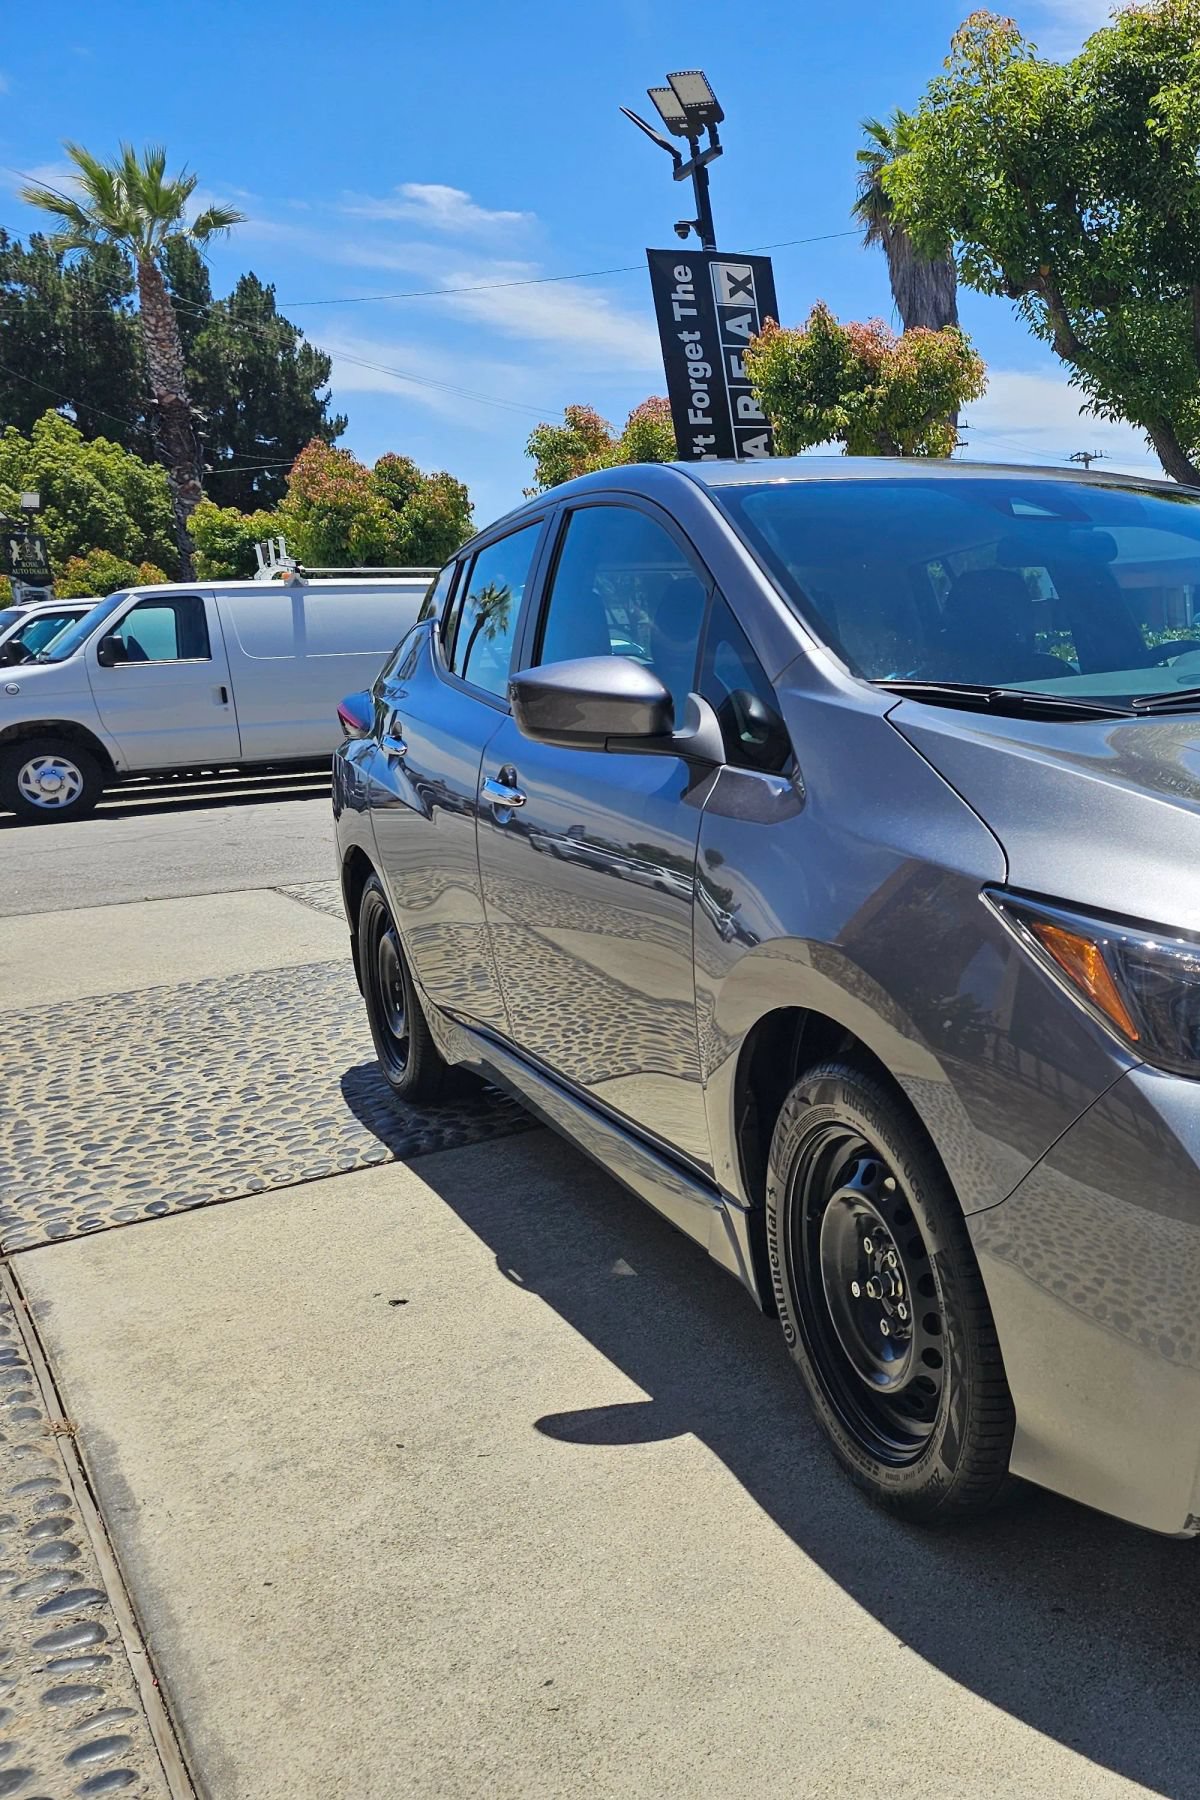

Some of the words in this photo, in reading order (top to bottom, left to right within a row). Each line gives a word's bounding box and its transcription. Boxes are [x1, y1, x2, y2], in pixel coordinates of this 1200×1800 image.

[671, 264, 698, 322] The
[677, 330, 713, 425] Forget
[903, 1161, 925, 1204] UC6
[766, 1204, 797, 1349] Continental
